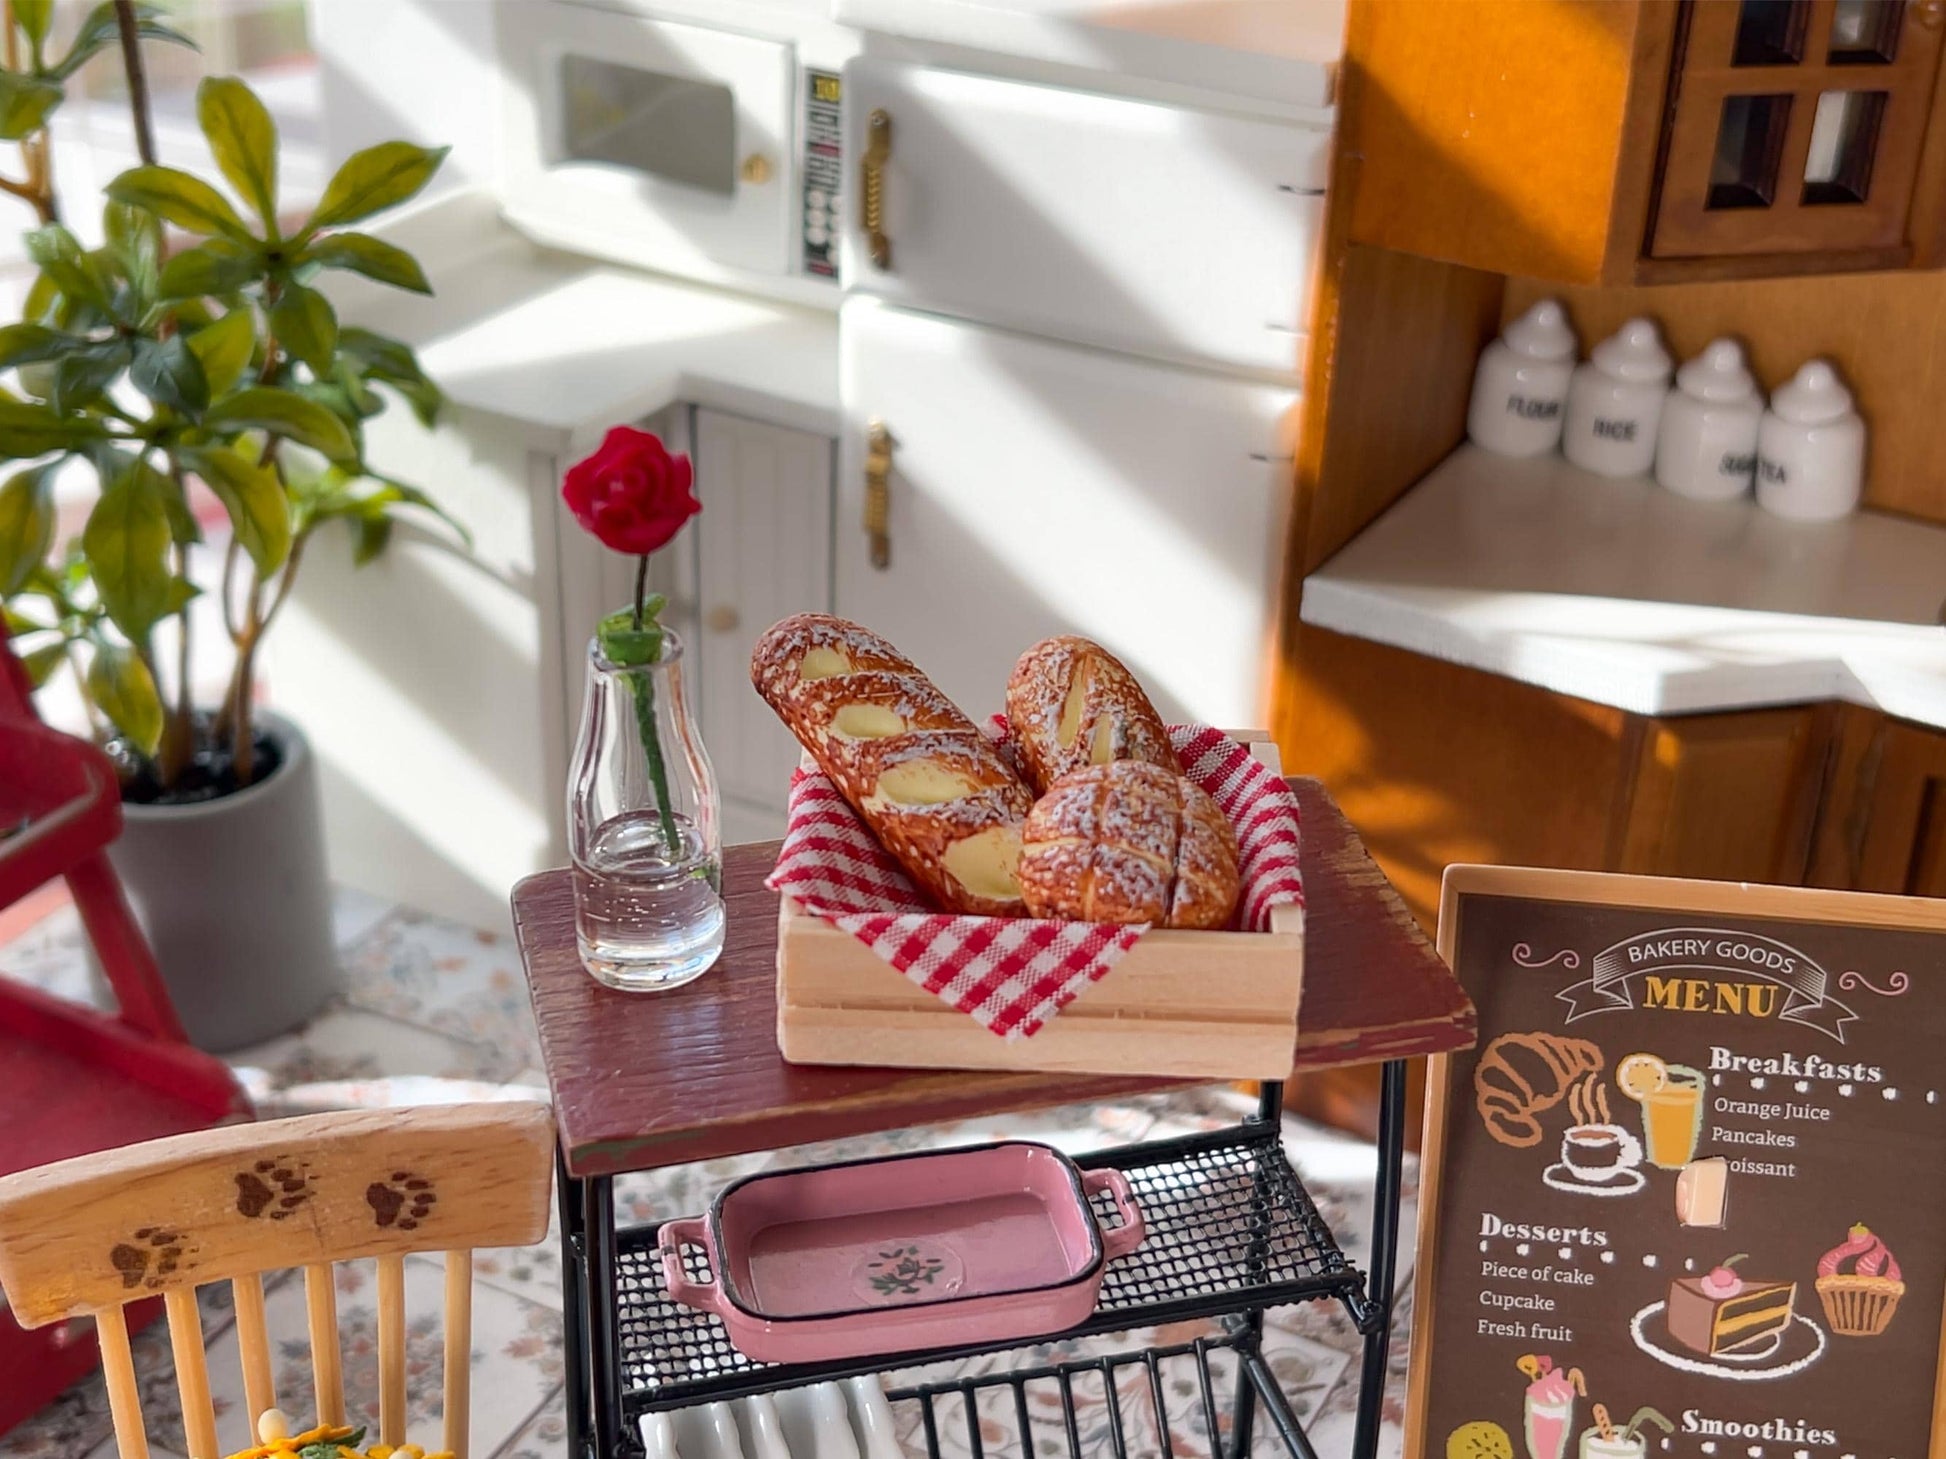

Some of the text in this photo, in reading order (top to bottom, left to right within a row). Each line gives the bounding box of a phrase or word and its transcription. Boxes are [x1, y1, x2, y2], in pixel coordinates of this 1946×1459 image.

[1593, 417, 1637, 440] RICE
[1628, 939, 1796, 974] BAKERY GOODS
[1643, 976, 1778, 1017] MENU
[1708, 1047, 1882, 1082] Breakfasts
[1714, 1097, 1830, 1120] Orange Juice
[1712, 1126, 1796, 1147] Pancakes
[1727, 1157, 1796, 1177] oissant
[1479, 1213, 1607, 1246] Desserts
[1482, 1261, 1594, 1285] Piece of cake
[1480, 1291, 1554, 1310] Cupcake
[1477, 1319, 1572, 1341] Fresh fruit
[1682, 1409, 1836, 1445] Smoothies
